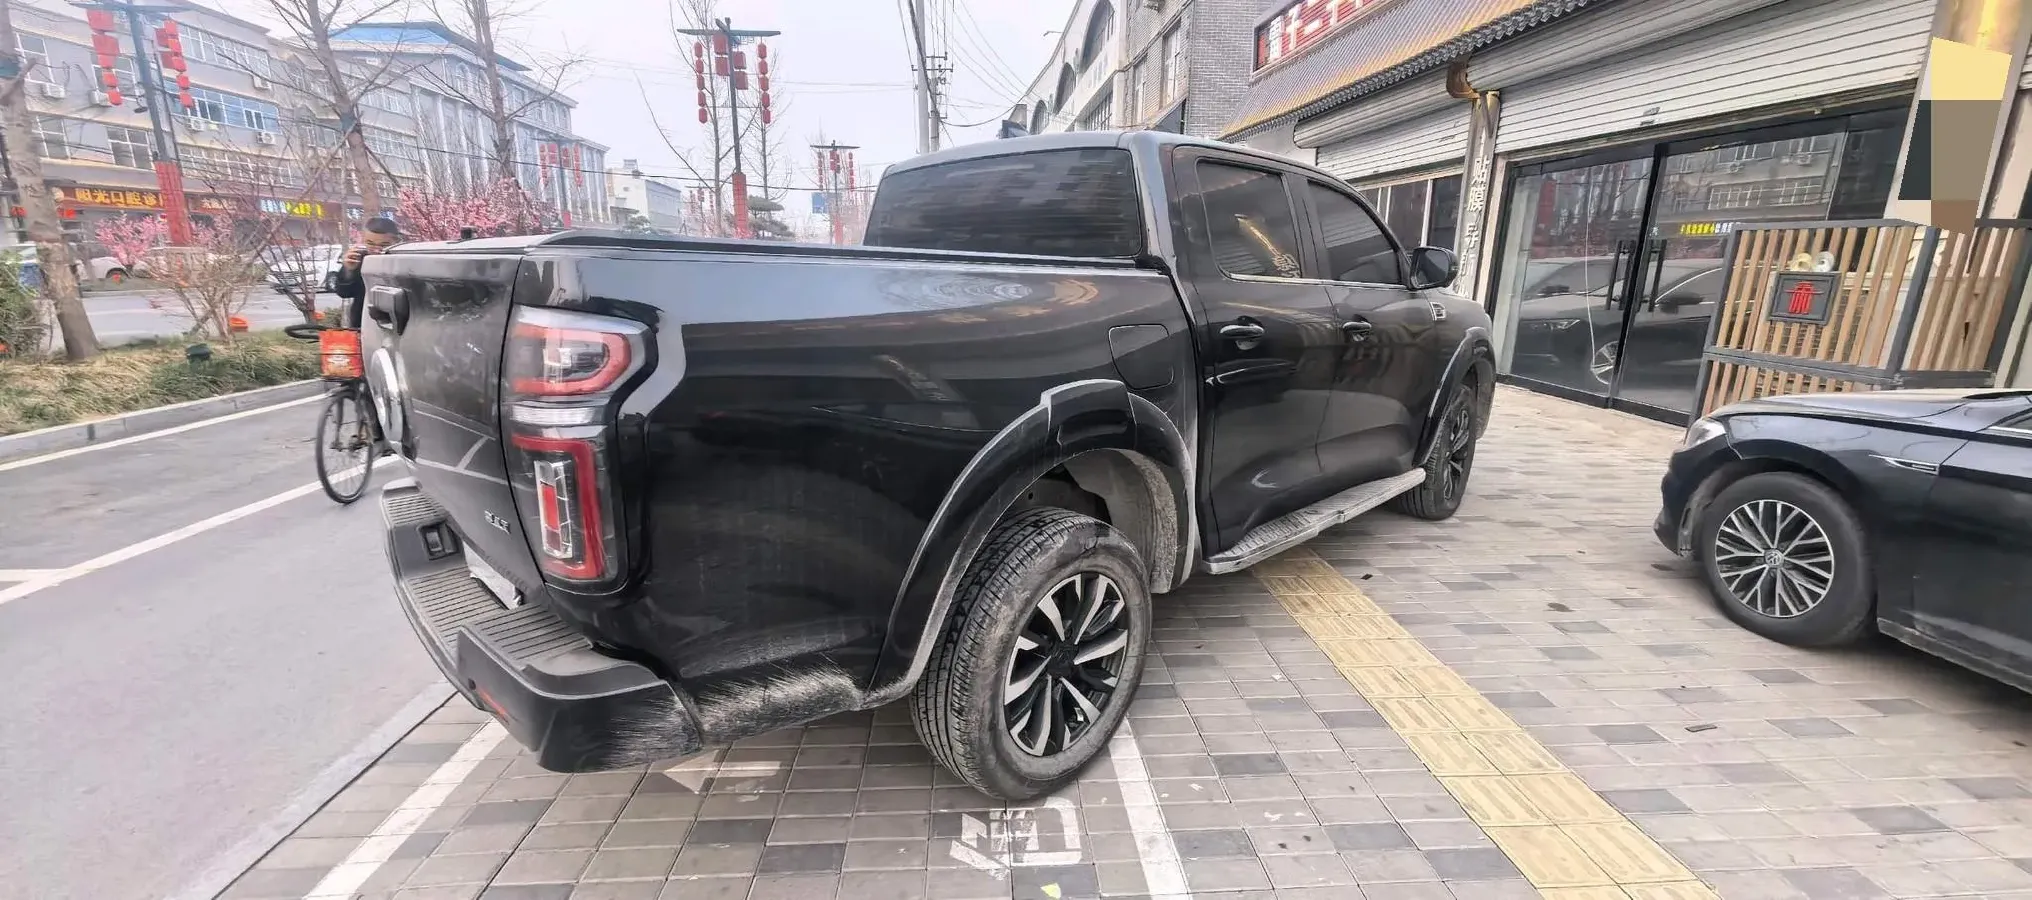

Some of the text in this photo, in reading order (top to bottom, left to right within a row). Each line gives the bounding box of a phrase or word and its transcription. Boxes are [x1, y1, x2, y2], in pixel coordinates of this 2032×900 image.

[74, 187, 165, 208] 阳光口腔诊
